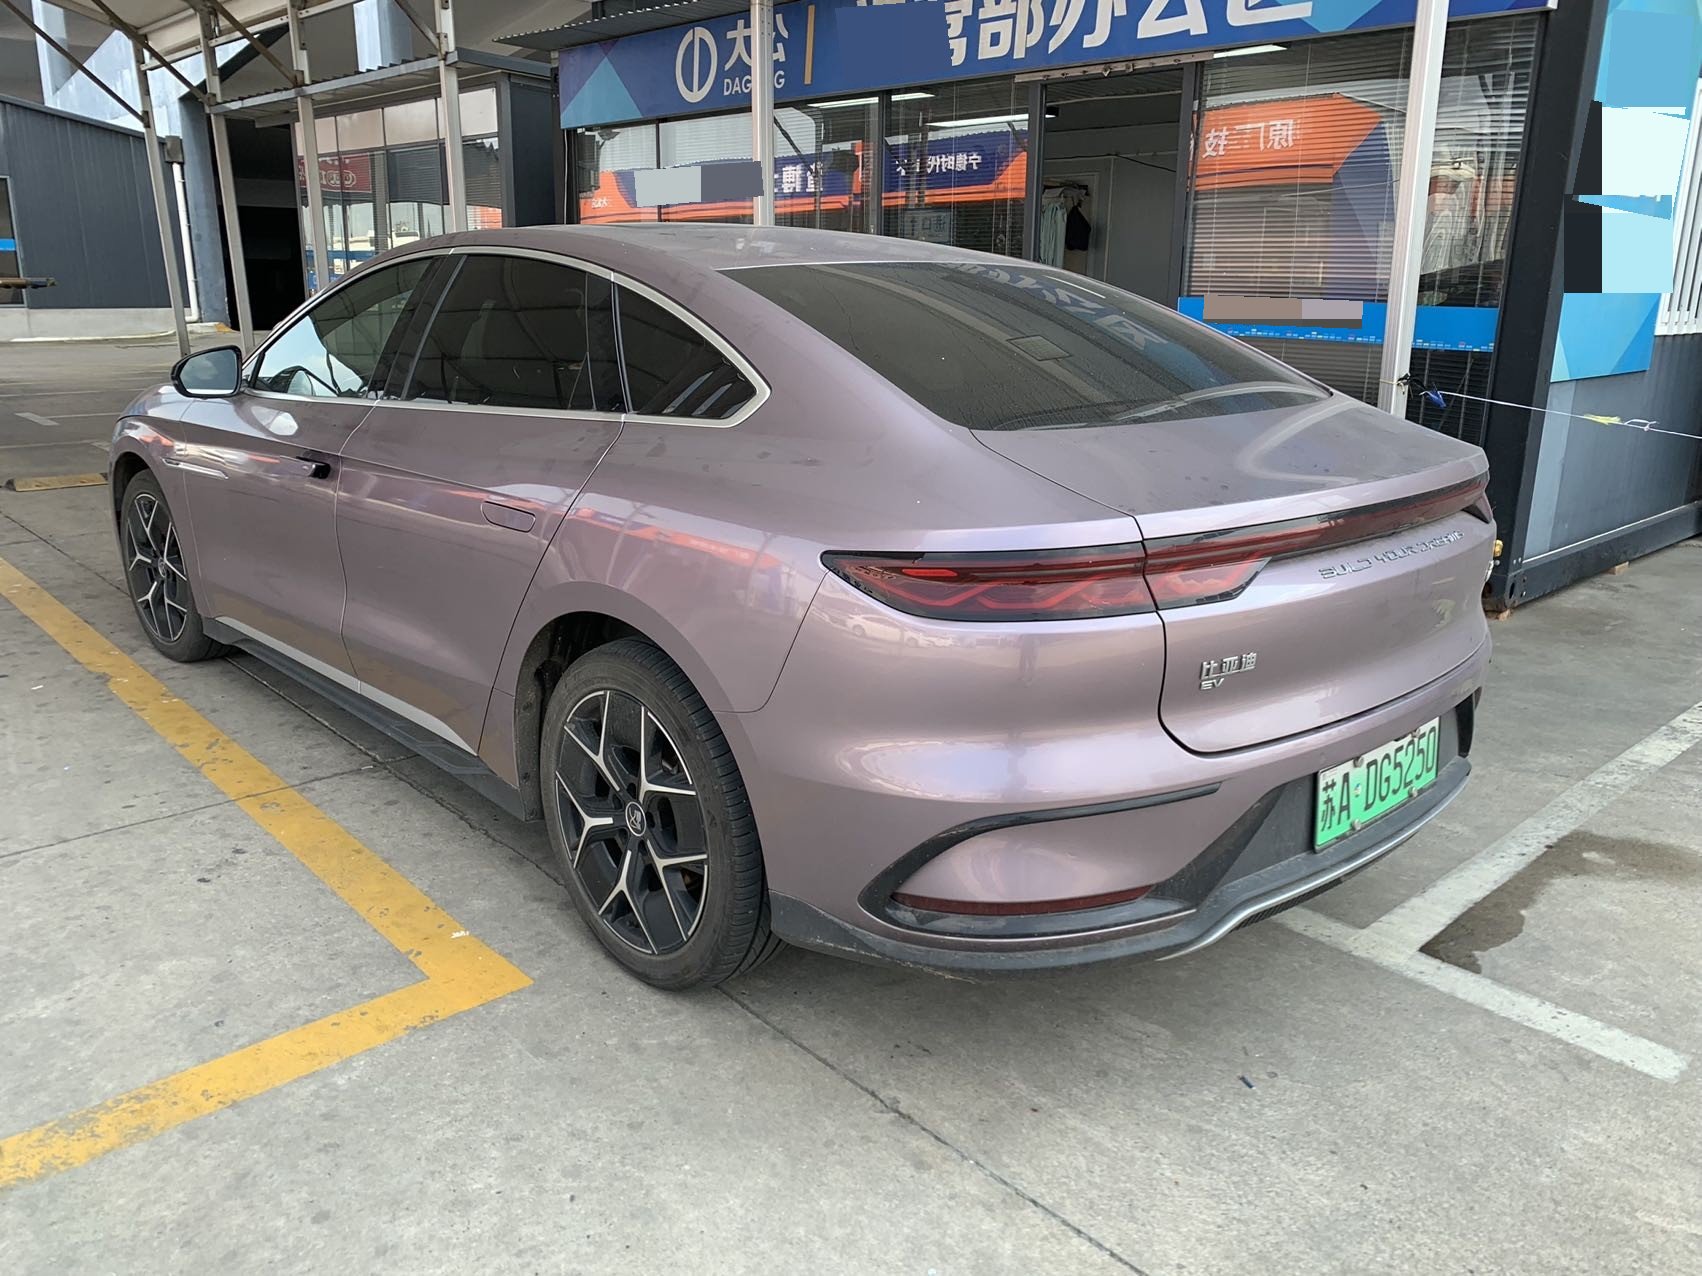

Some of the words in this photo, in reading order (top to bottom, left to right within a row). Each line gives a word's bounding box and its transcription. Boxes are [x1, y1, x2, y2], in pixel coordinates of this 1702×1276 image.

[723, 70, 785, 96] DAGG
[1373, 546, 1418, 564] YOUR
[1200, 652, 1257, 680] 比亚迪
[1200, 677, 1225, 690] EV
